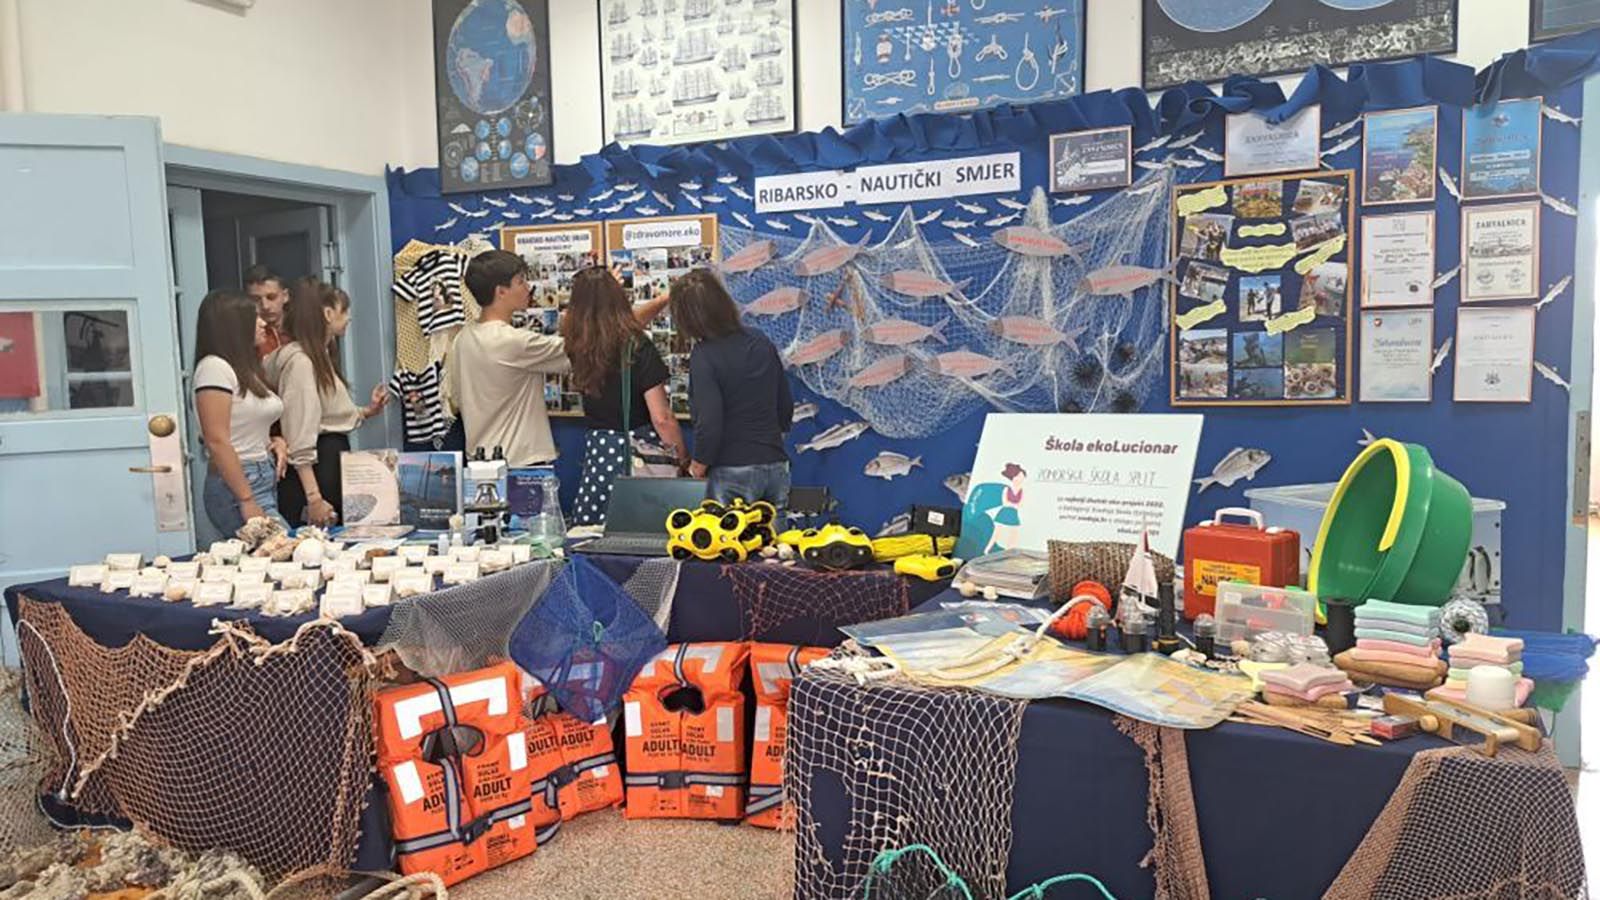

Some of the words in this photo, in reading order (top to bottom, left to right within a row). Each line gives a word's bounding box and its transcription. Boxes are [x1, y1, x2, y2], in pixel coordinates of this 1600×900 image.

[759, 183, 838, 204] RIBARSKO
[860, 168, 941, 192] NAUTIČKI
[956, 162, 1015, 183] SMJER
[1045, 435, 1084, 452] Škola
[1086, 439, 1179, 454] ekoLucionar
[1090, 466, 1120, 482] ŠKOLA
[1129, 471, 1157, 485] SPLIT
[527, 735, 560, 753] DULT
[561, 729, 595, 747] ADULT
[682, 743, 716, 757] ADULT
[473, 776, 513, 799] ADULT
